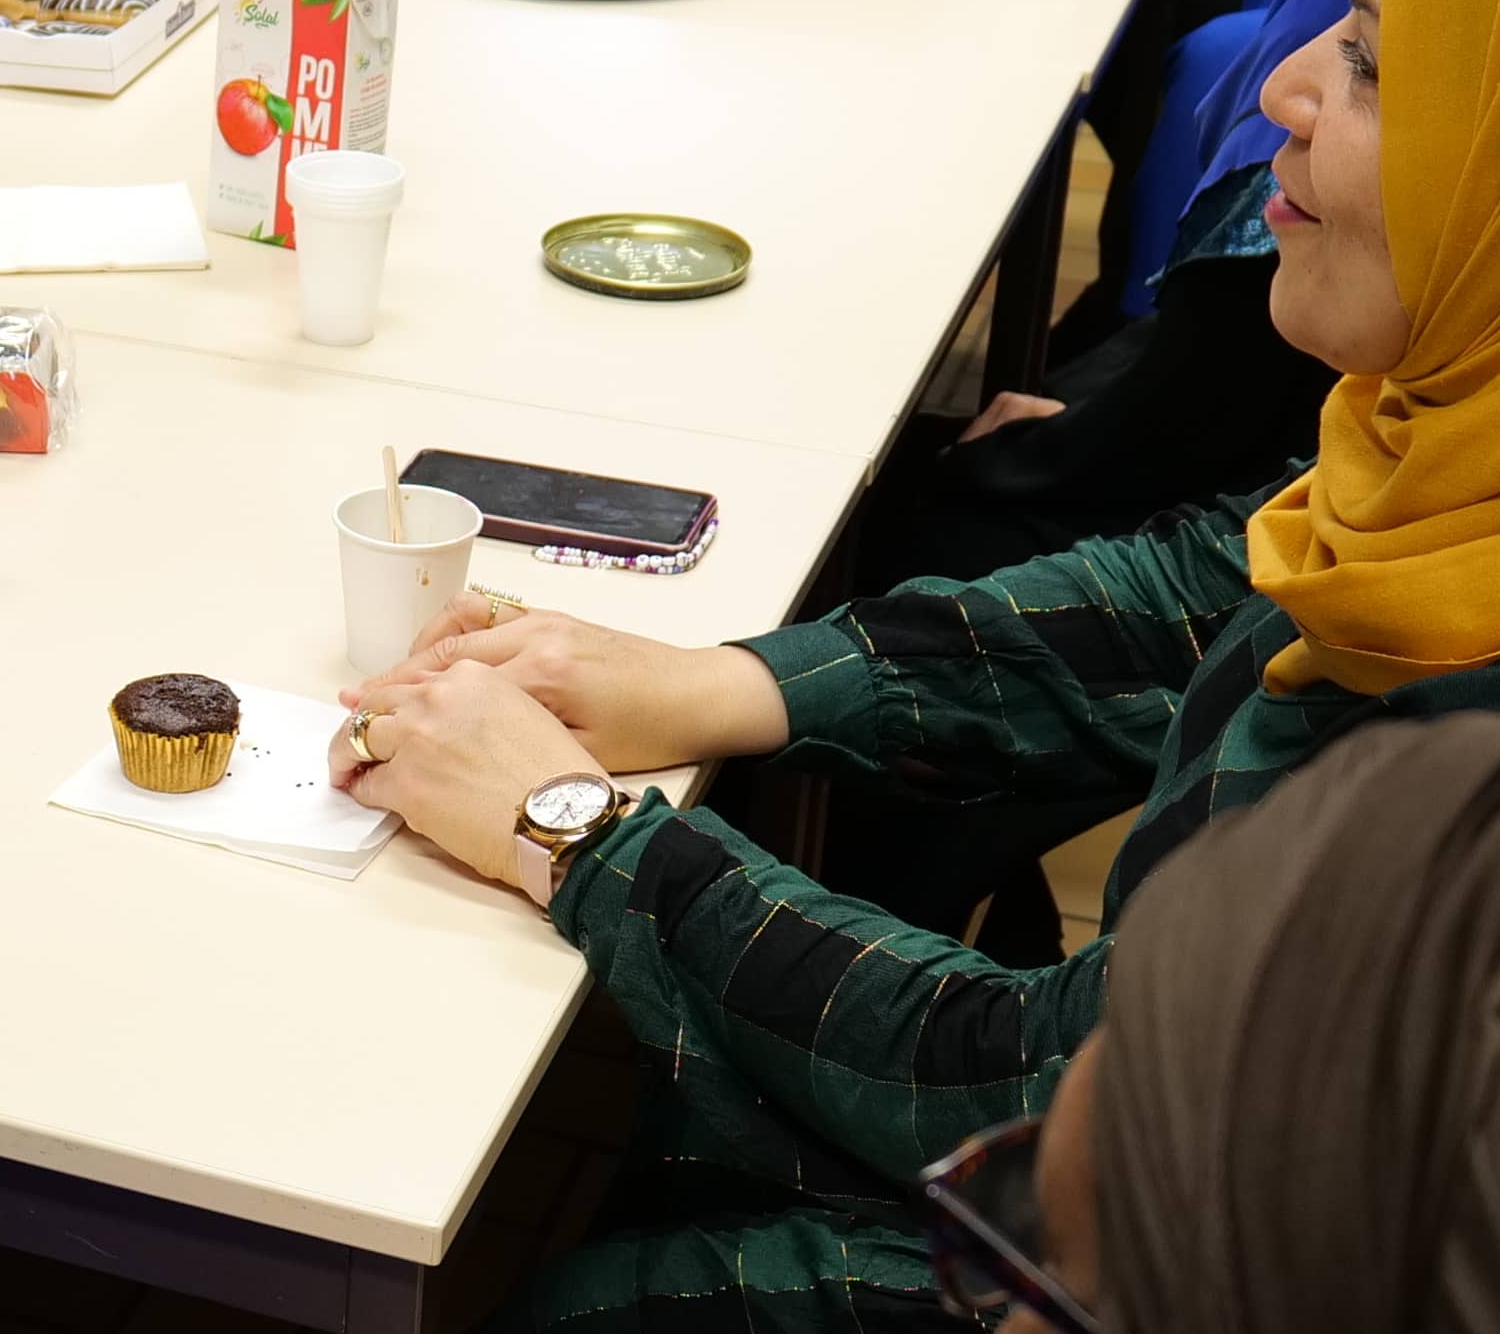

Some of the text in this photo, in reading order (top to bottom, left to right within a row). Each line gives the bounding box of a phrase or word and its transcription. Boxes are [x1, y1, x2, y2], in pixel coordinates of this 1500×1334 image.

[244, 4, 279, 26] Solal
[298, 54, 335, 99] PO
[293, 97, 332, 144] M
